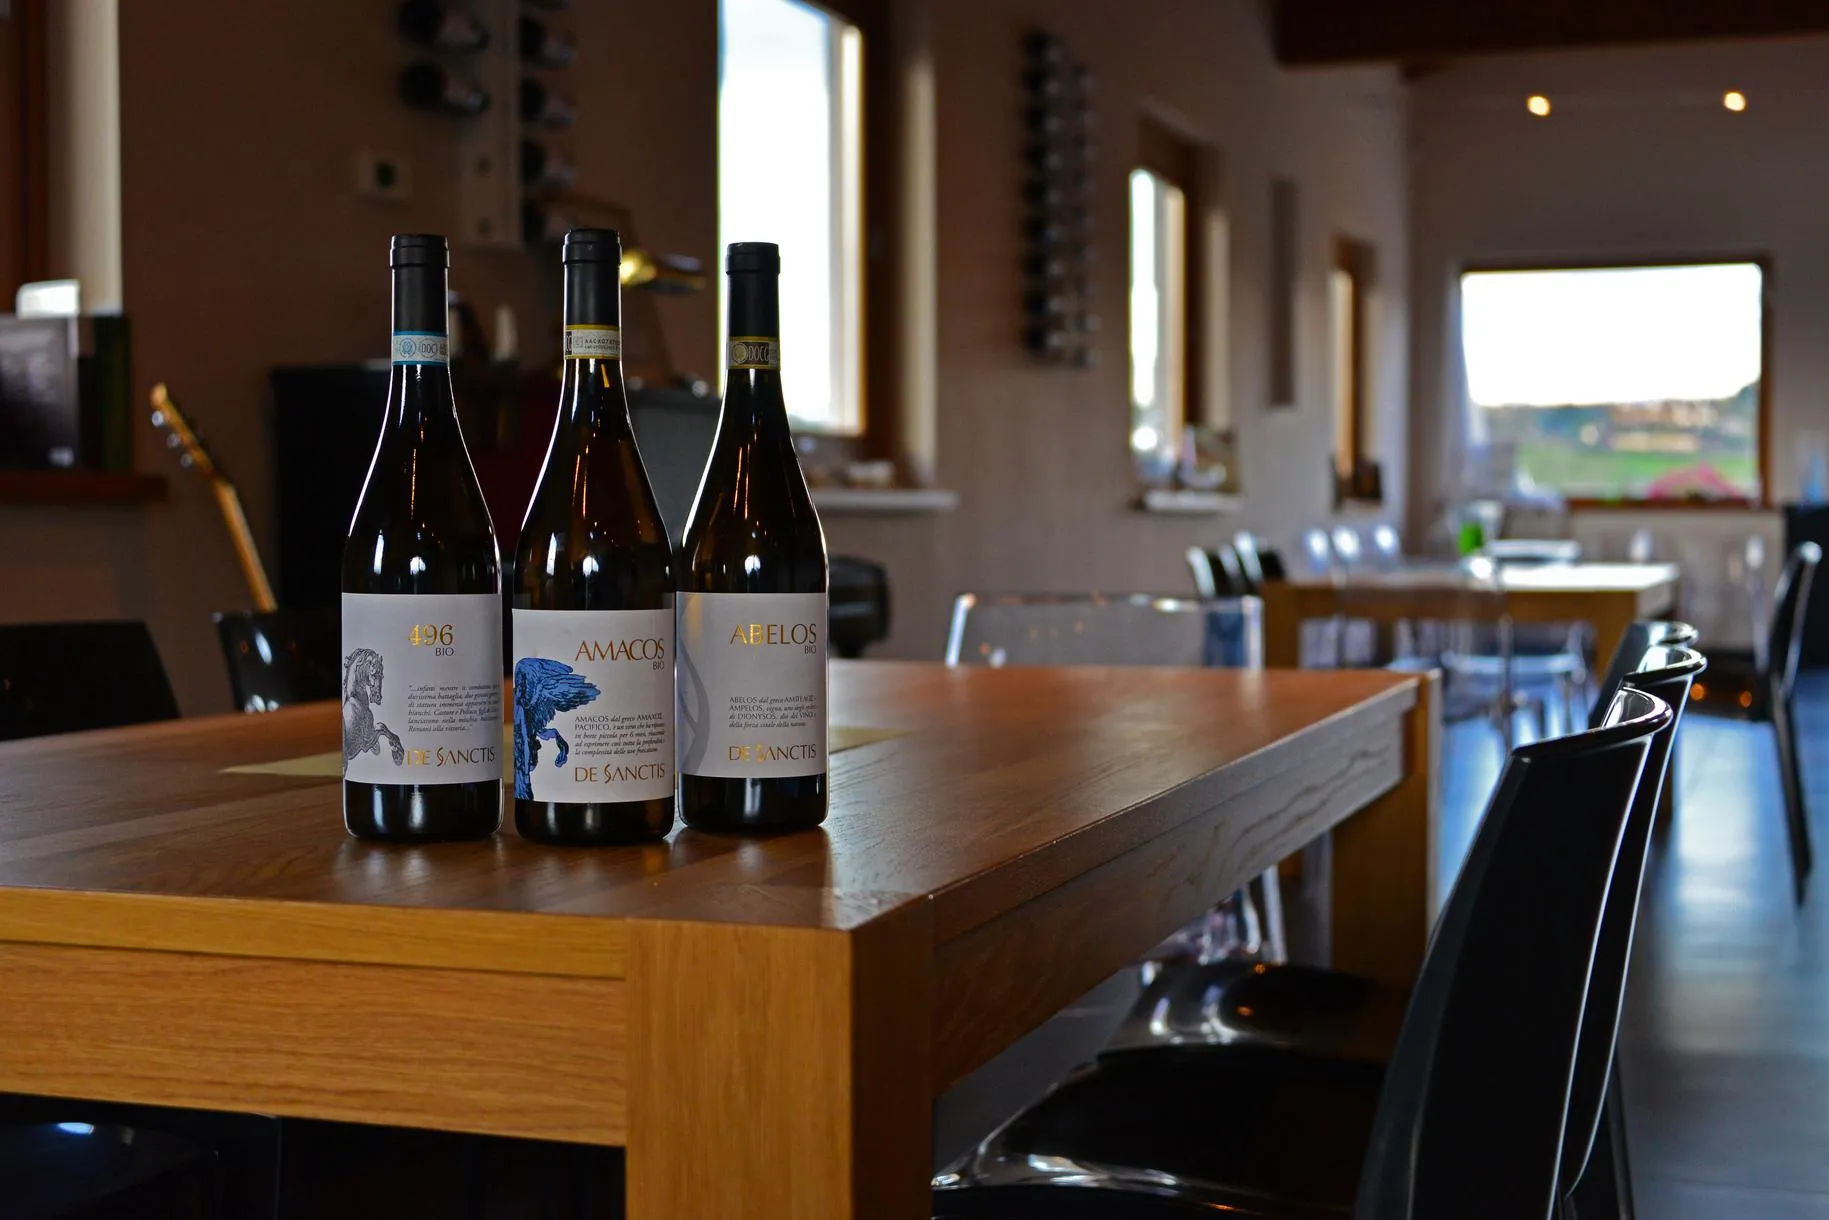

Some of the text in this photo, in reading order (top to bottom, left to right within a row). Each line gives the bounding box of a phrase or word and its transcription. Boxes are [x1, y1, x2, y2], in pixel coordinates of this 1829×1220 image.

[407, 624, 454, 646] 496
[730, 623, 817, 645] ABELOS
[435, 647, 455, 657] BIO
[575, 638, 665, 661] AMACOS
[804, 645, 817, 655] BIO
[652, 661, 665, 671] BIO
[574, 723, 612, 731] PACIFICO,
[575, 715, 609, 723] AMACOS
[407, 746, 495, 767] DE SANCTIS
[729, 743, 816, 763] DE SANCTIS
[574, 763, 665, 784] DE SANCTIS
